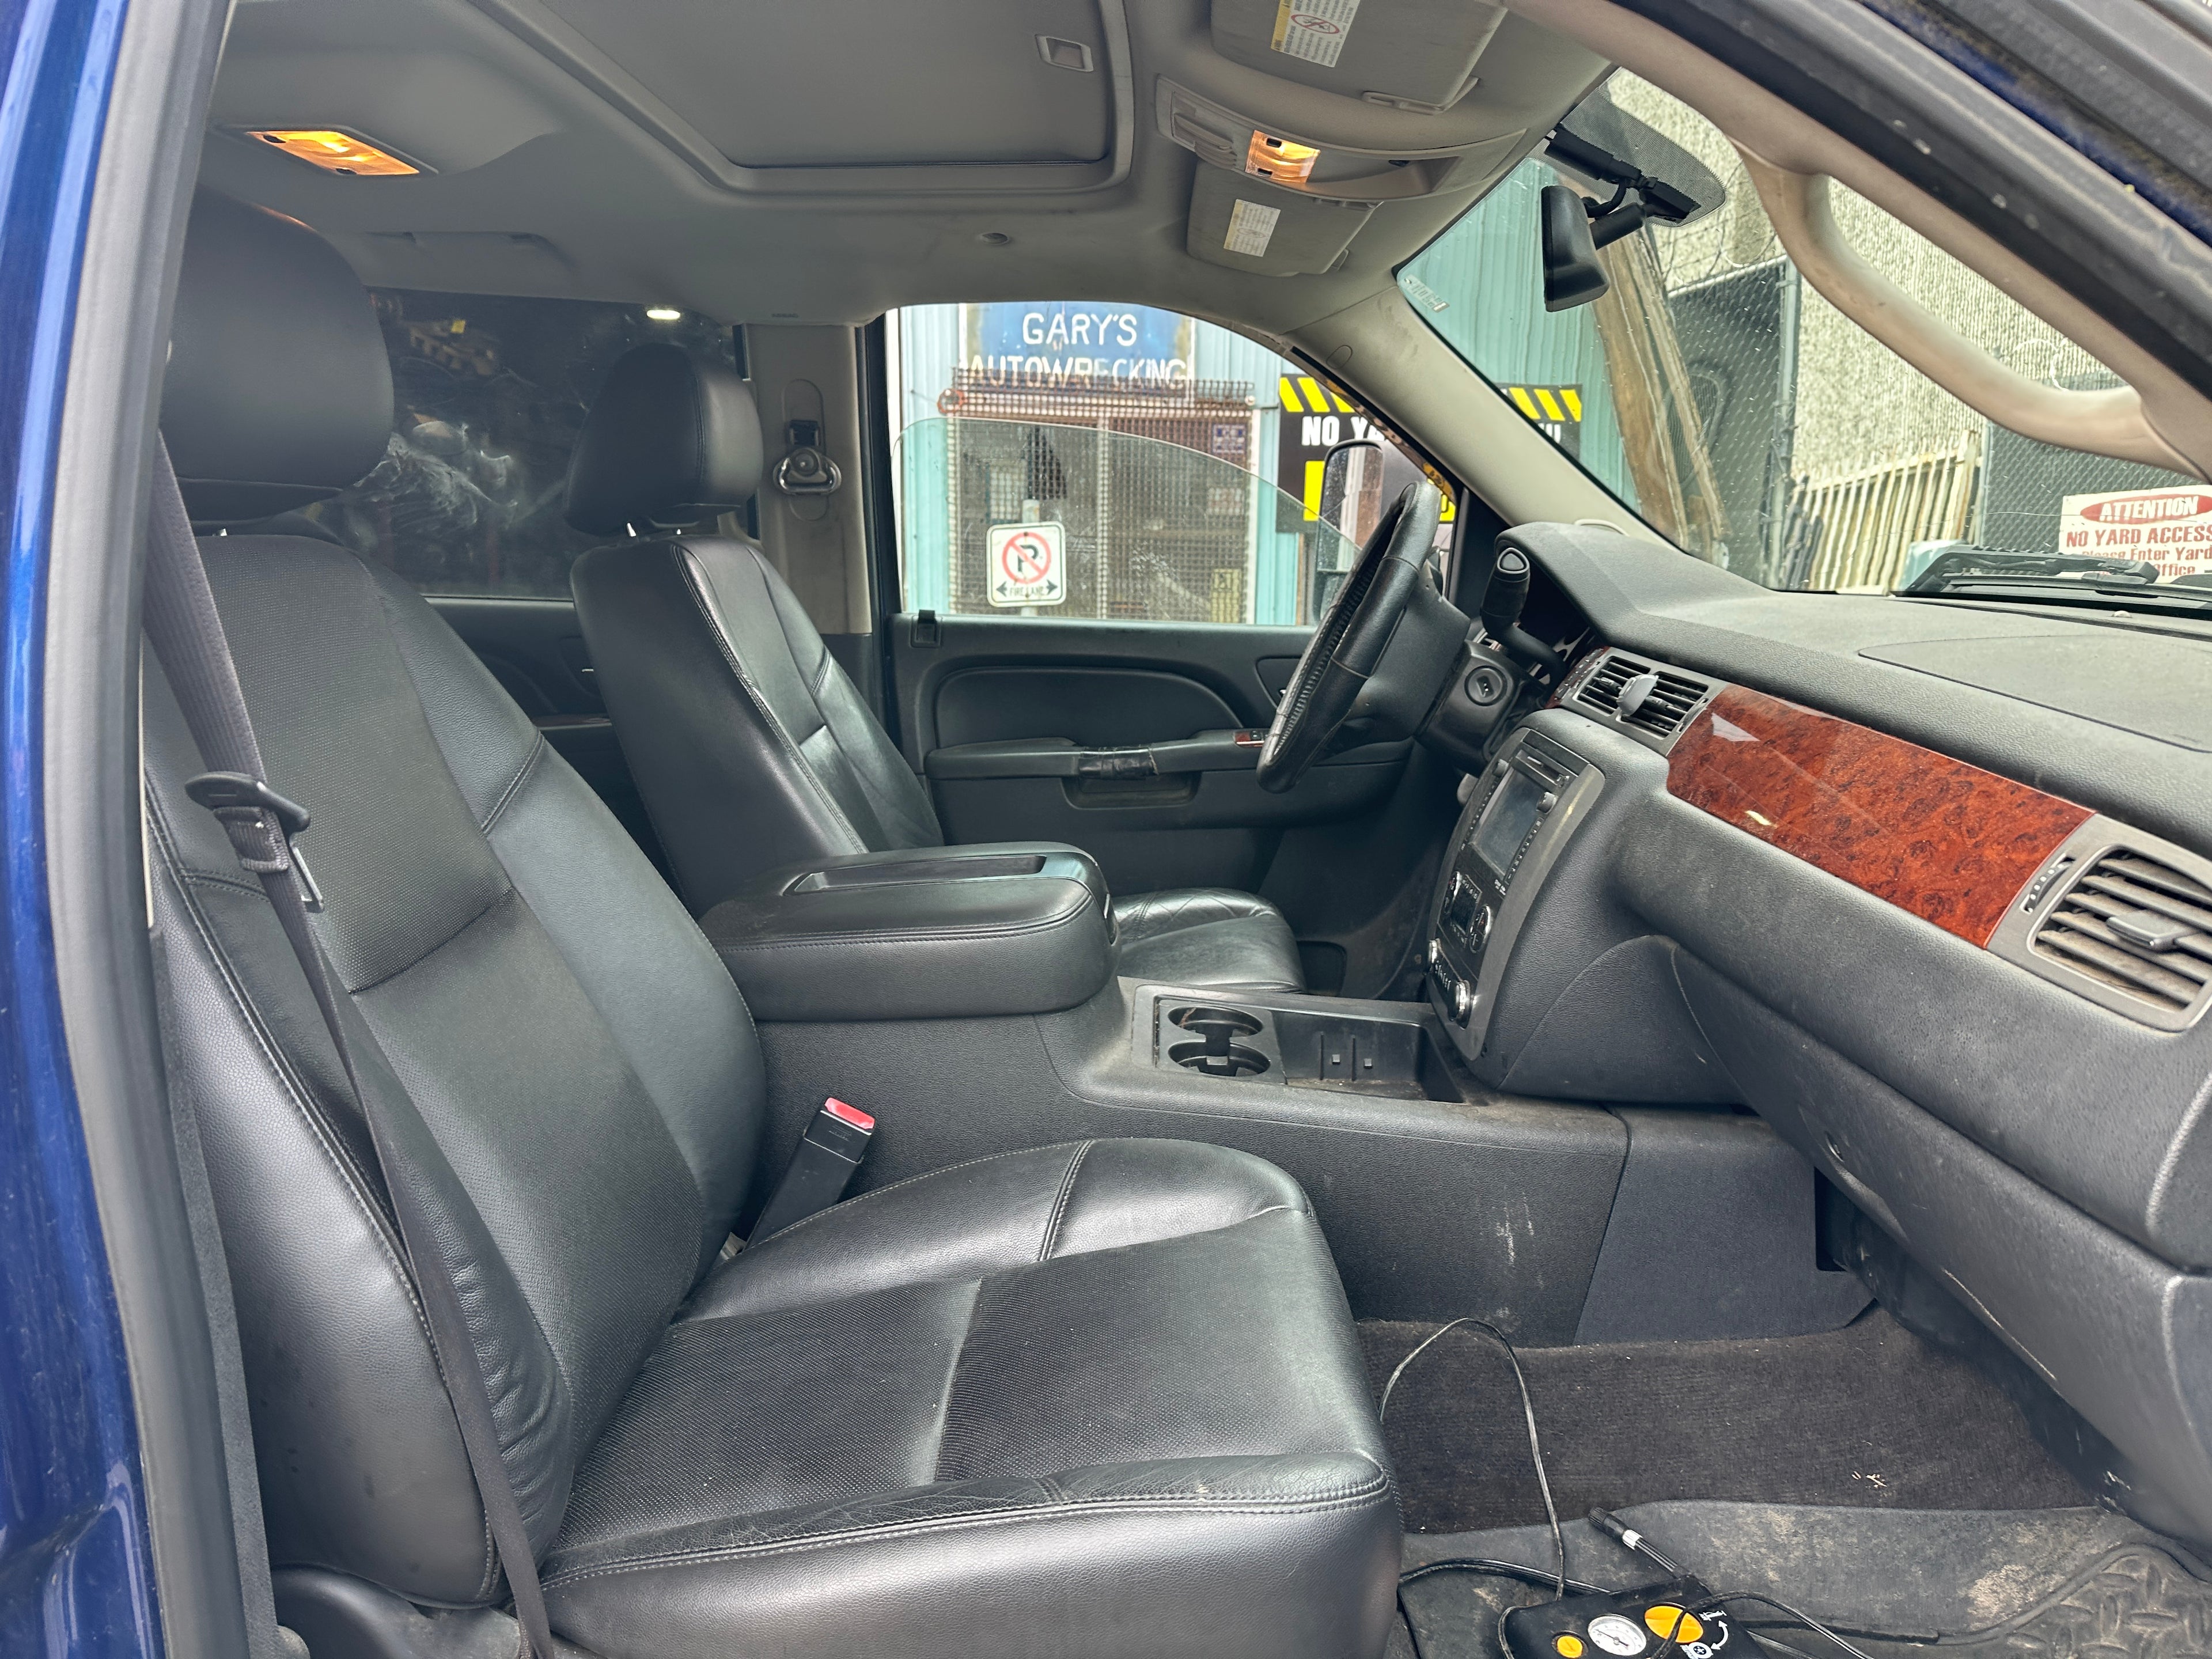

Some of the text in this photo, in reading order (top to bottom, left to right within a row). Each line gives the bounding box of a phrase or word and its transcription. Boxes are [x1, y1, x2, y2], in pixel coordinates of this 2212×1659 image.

[1022, 313, 1138, 346] GARY'S
[969, 355, 1187, 389] AUTOWRECKING
[1301, 415, 1340, 446] NO
[2099, 495, 2199, 521] ATTENTION
[2066, 531, 2089, 547] NO
[2094, 529, 2142, 546] YARD
[2130, 548, 2170, 561] Enter
[2175, 544, 2212, 561] Yard
[1009, 587, 1024, 596] FIRE
